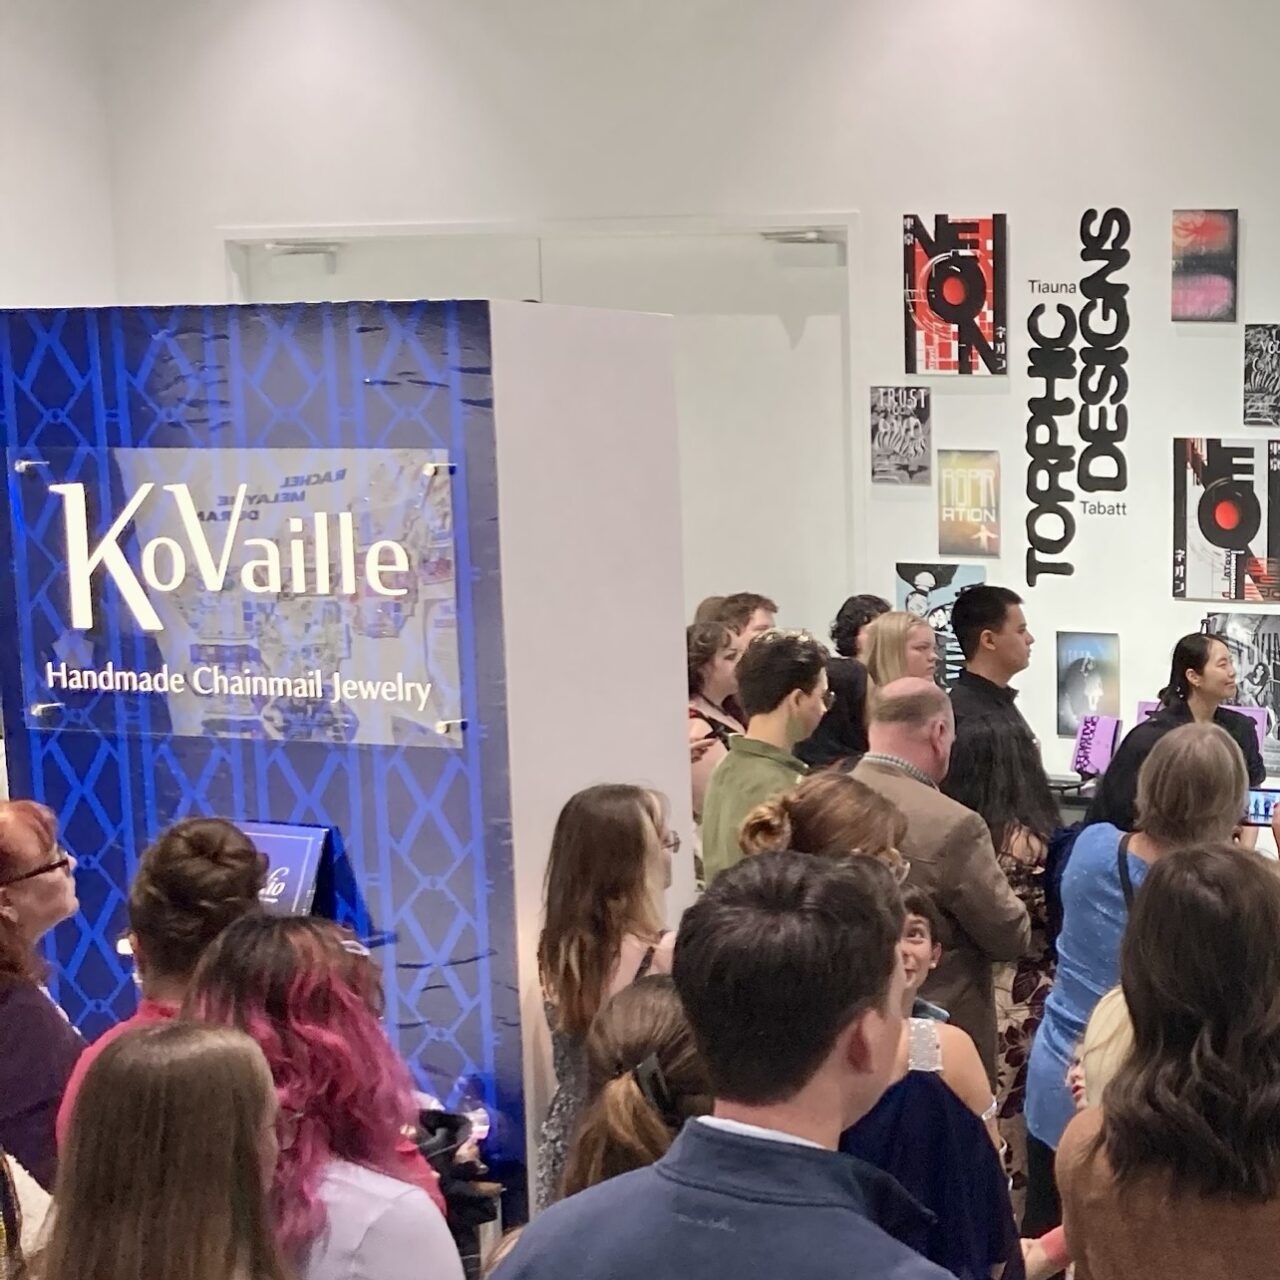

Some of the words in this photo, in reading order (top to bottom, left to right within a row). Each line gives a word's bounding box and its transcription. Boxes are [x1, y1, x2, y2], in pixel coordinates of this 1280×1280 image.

[1028, 280, 1077, 294] Tiauna
[1078, 207, 1130, 492] DESIGNS
[878, 388, 927, 408] TRUST
[1026, 303, 1077, 587] TORPHIC
[941, 507, 997, 522] ATION
[1079, 500, 1127, 515] Tabatt
[49, 483, 409, 630] KoVaille
[47, 662, 185, 692] Handmade
[192, 666, 323, 698] Chainmail
[331, 672, 432, 711] Jewelry
